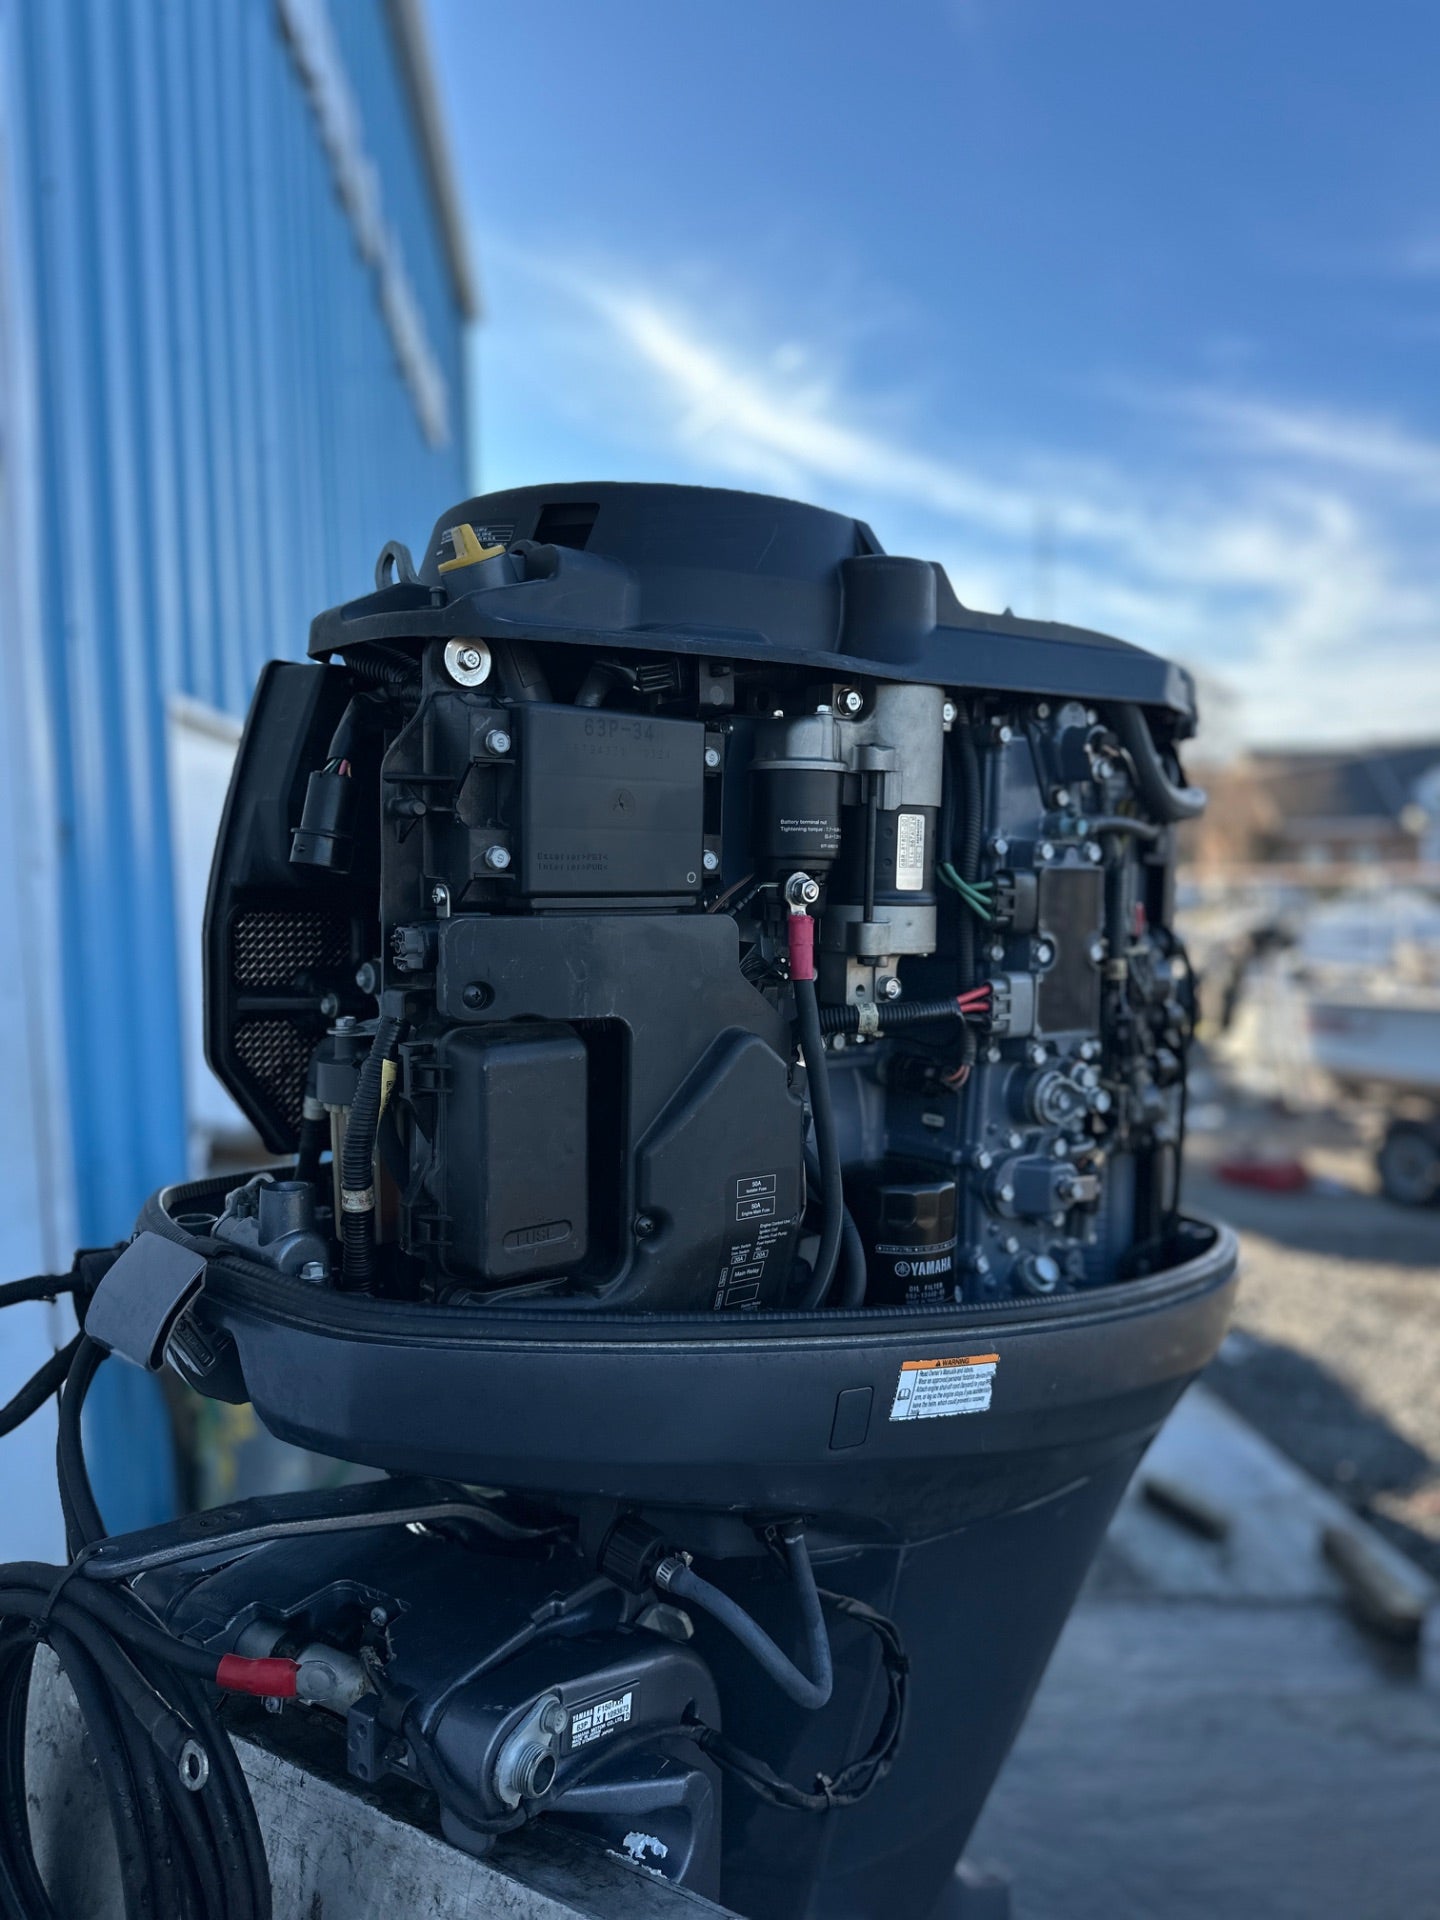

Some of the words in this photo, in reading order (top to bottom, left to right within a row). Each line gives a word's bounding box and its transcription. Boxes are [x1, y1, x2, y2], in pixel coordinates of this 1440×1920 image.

[910, 1256, 952, 1276] YAMAHA
[908, 1285, 920, 1293] OIL
[924, 1281, 943, 1291] FILTER
[942, 1358, 970, 1367] WARNING
[572, 1708, 593, 1723] YAMAHA
[596, 1714, 601, 1723] X
[576, 1721, 588, 1731] 63P
